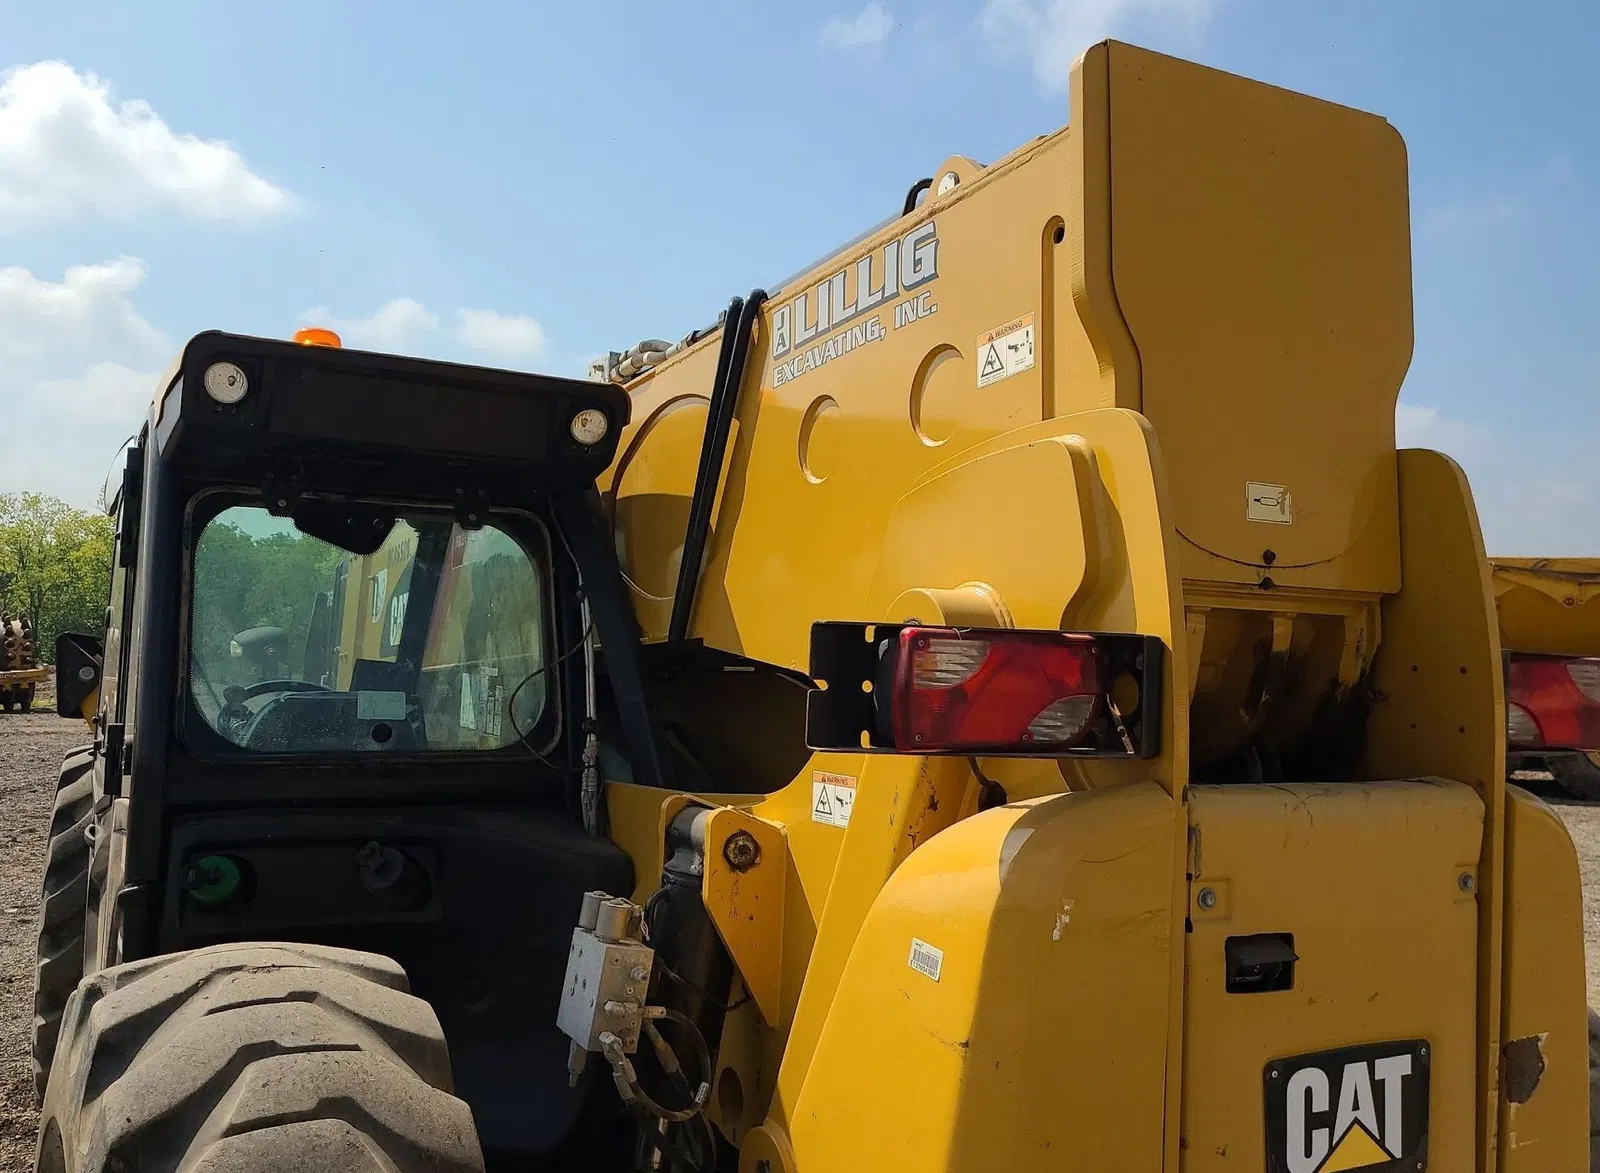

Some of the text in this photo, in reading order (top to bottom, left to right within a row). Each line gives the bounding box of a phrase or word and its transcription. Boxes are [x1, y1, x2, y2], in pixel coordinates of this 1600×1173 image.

[793, 220, 940, 350] LILLIG
[995, 320, 1023, 338] WARNING
[772, 290, 938, 389] EXCAVATING, INC.
[826, 775, 849, 786] WARNING
[1286, 1053, 1412, 1173] CAT
